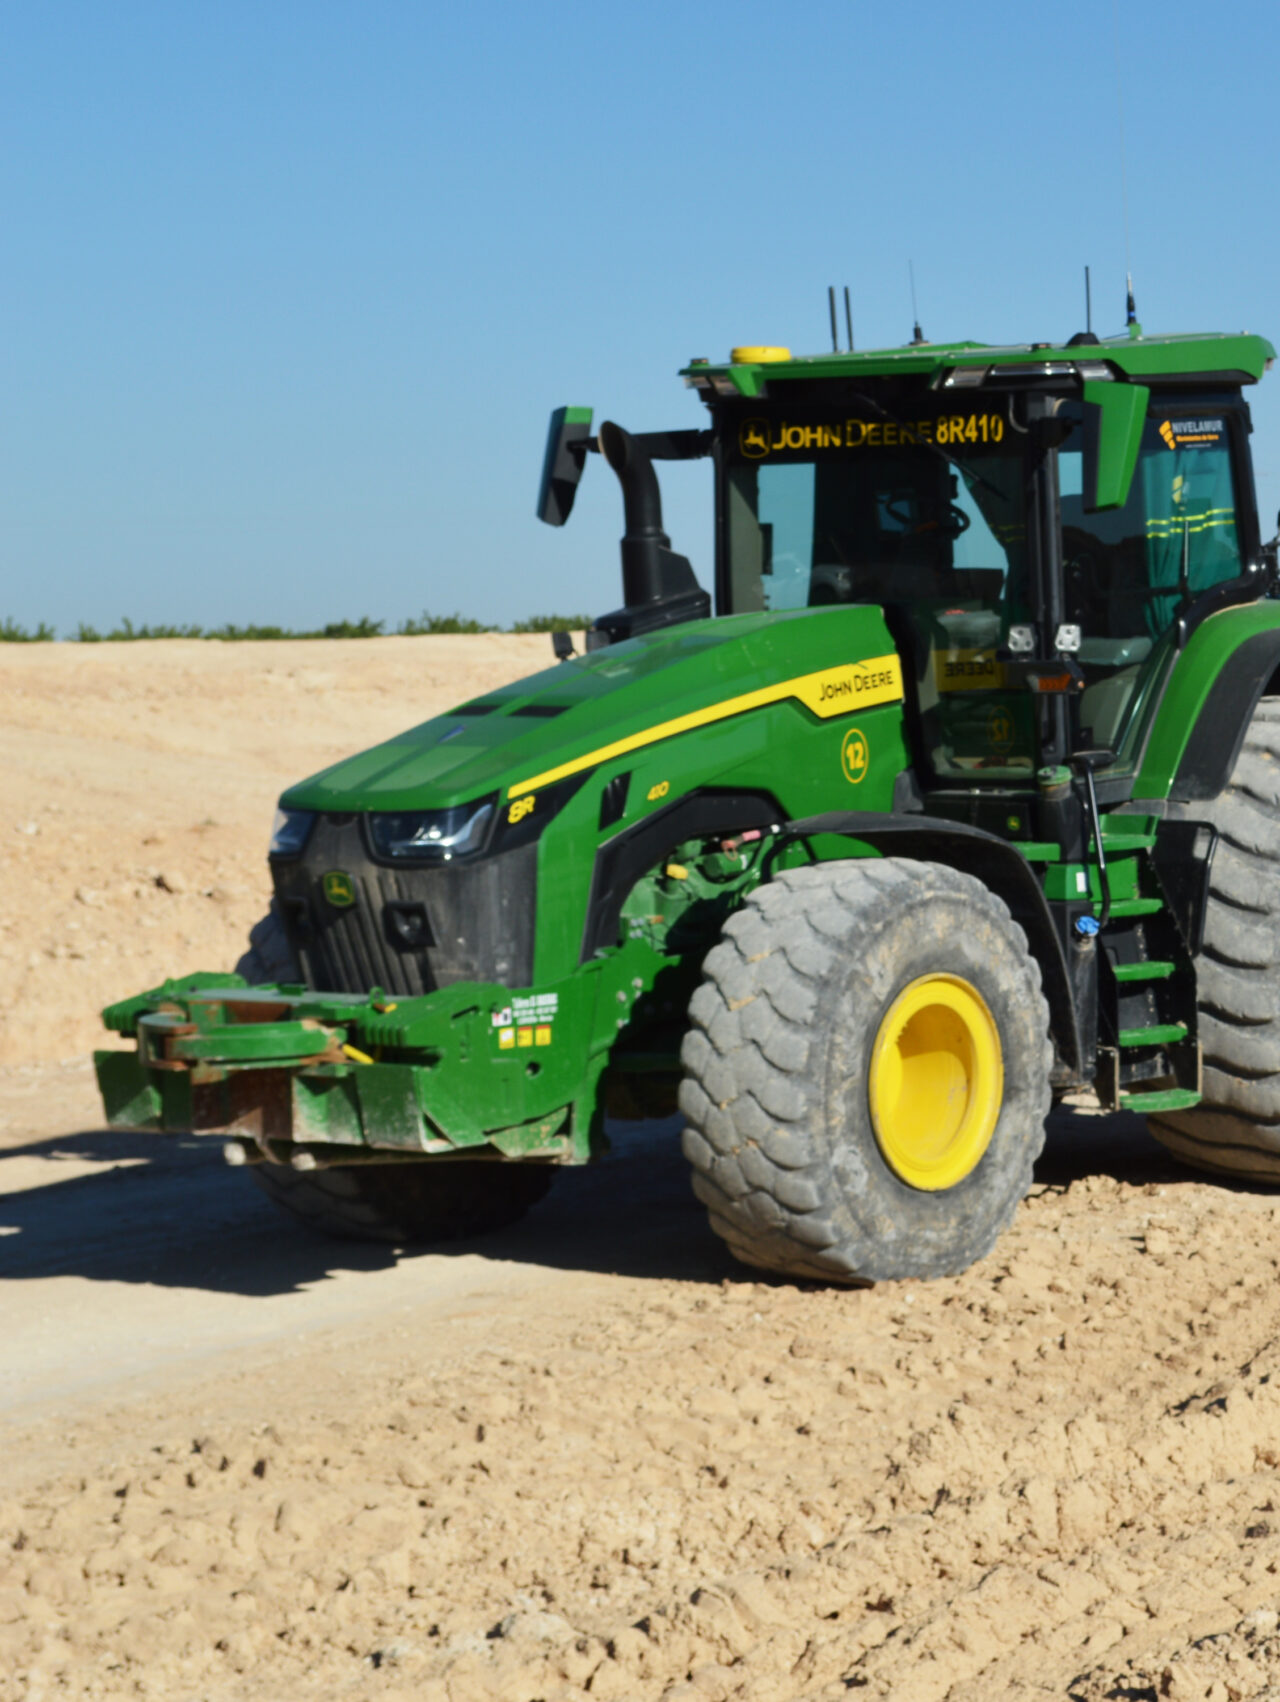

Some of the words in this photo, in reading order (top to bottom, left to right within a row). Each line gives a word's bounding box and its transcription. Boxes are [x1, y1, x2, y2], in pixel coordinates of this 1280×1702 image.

[772, 424, 842, 449] JOHN
[845, 418, 932, 446] DEERE
[935, 413, 1003, 444] 8R410
[819, 680, 853, 702] JOHN
[853, 670, 894, 692] DEERE
[846, 741, 865, 770] 12
[647, 780, 669, 800] 410
[508, 795, 535, 824] 8R
